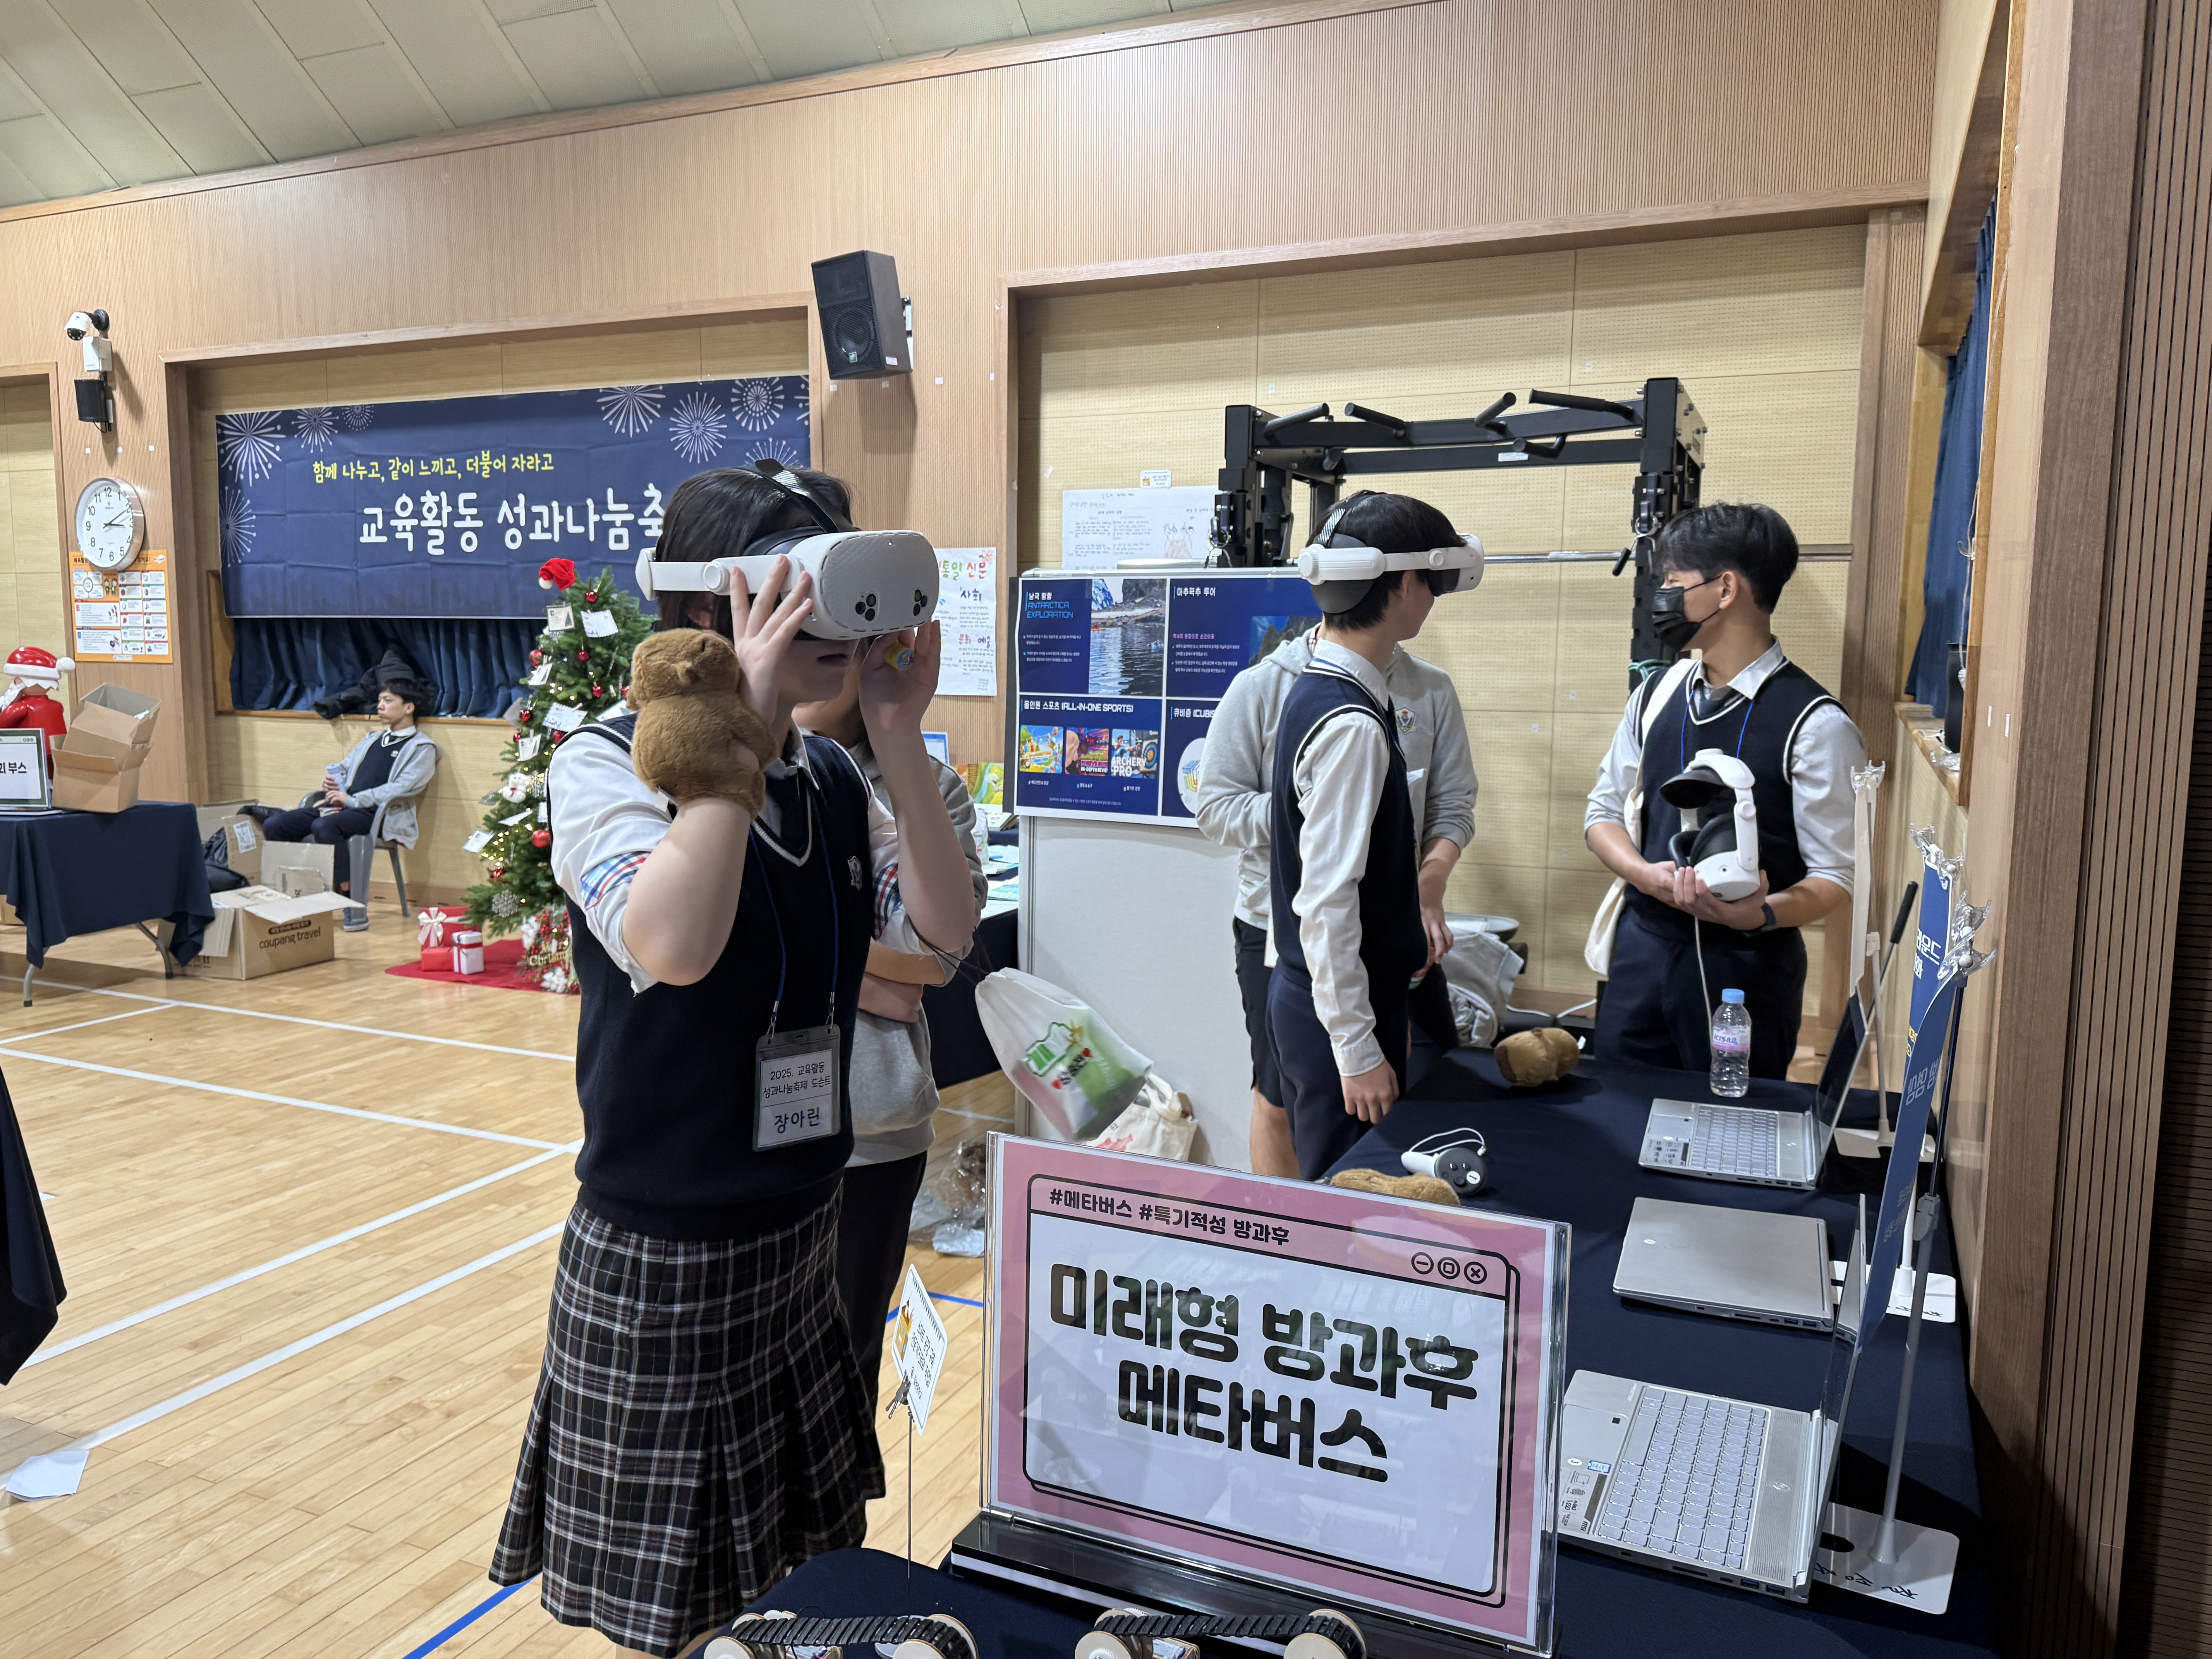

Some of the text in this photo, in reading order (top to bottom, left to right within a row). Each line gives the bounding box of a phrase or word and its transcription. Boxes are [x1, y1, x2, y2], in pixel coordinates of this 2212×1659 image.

[314, 452, 553, 483] 함께 나누고, 같이 느끼고, 더불어 자라고
[104, 487, 112, 497] 12
[94, 493, 101, 503] 11
[88, 506, 95, 515] 10
[86, 521, 91, 531] 9
[360, 490, 483, 555] 교육활동
[91, 537, 96, 547] 8
[99, 548, 103, 558] 7
[109, 551, 114, 561] 6
[120, 546, 124, 556] 5
[967, 562, 987, 579] 신문
[960, 588, 982, 602] 사회
[1204, 587, 1216, 596] 투어
[1042, 701, 1060, 710] 스포츠
[1111, 756, 1147, 766] ARCHERY
[9, 762, 27, 774] 부스
[1113, 766, 1132, 777] PRO
[259, 934, 296, 949] coupang
[297, 926, 321, 941] travel
[771, 1061, 825, 1081] 2025. 교육활동
[763, 1080, 808, 1098] 성과나눔축제
[1049, 1187, 1290, 1246] #메타버스 #특기적성 방과후
[1051, 1264, 1479, 1410] 미래형 방과후
[1118, 1359, 1388, 1483] 메타버스
